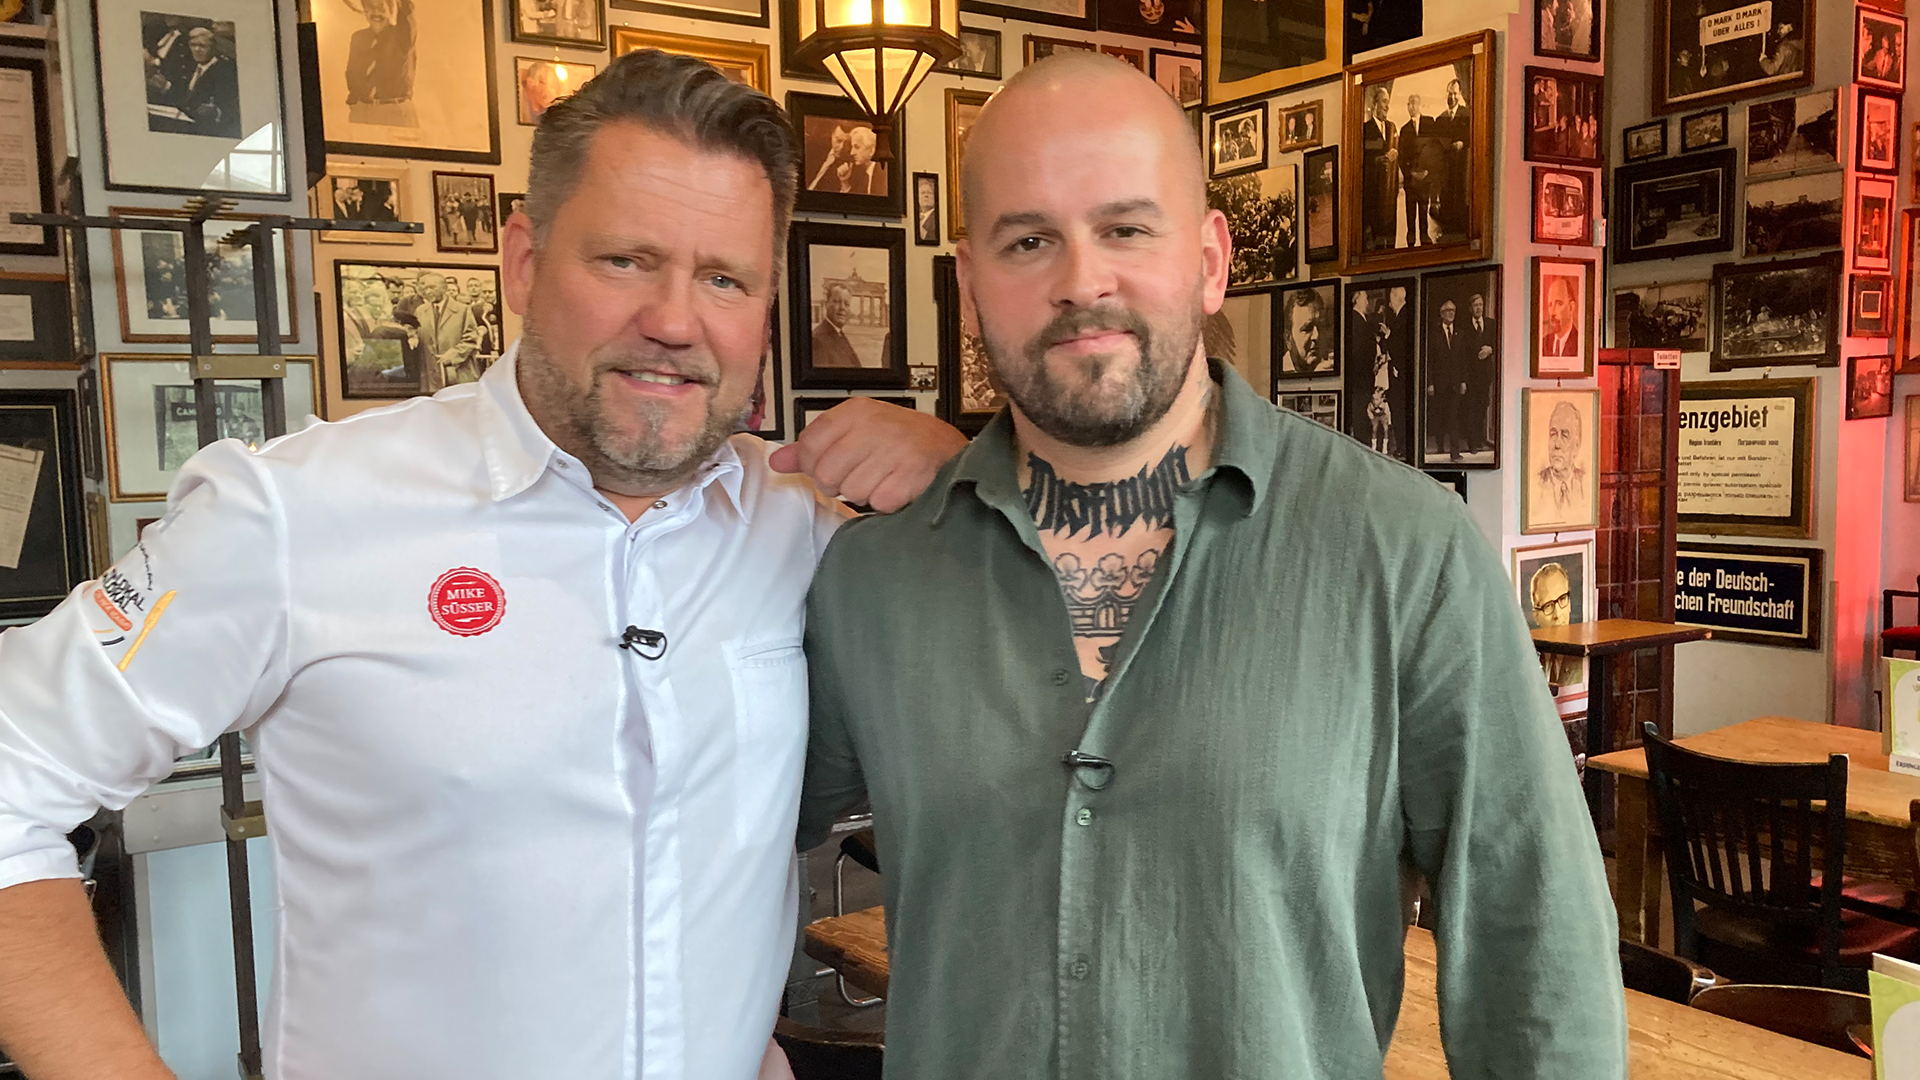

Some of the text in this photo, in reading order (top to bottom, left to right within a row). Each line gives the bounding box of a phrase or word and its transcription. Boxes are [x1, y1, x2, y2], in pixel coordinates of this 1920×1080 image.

[1713, 15, 1733, 26] MARK
[1742, 8, 1763, 19] MARK
[1734, 20, 1755, 32] ALLES
[1679, 405, 1768, 433] enzgebiet
[1688, 566, 1712, 588] der
[1715, 568, 1775, 592] Deutsch-
[446, 588, 486, 600] MIKE
[441, 602, 495, 615] SÜSSER
[1674, 591, 1795, 620] chen Freundschaft
